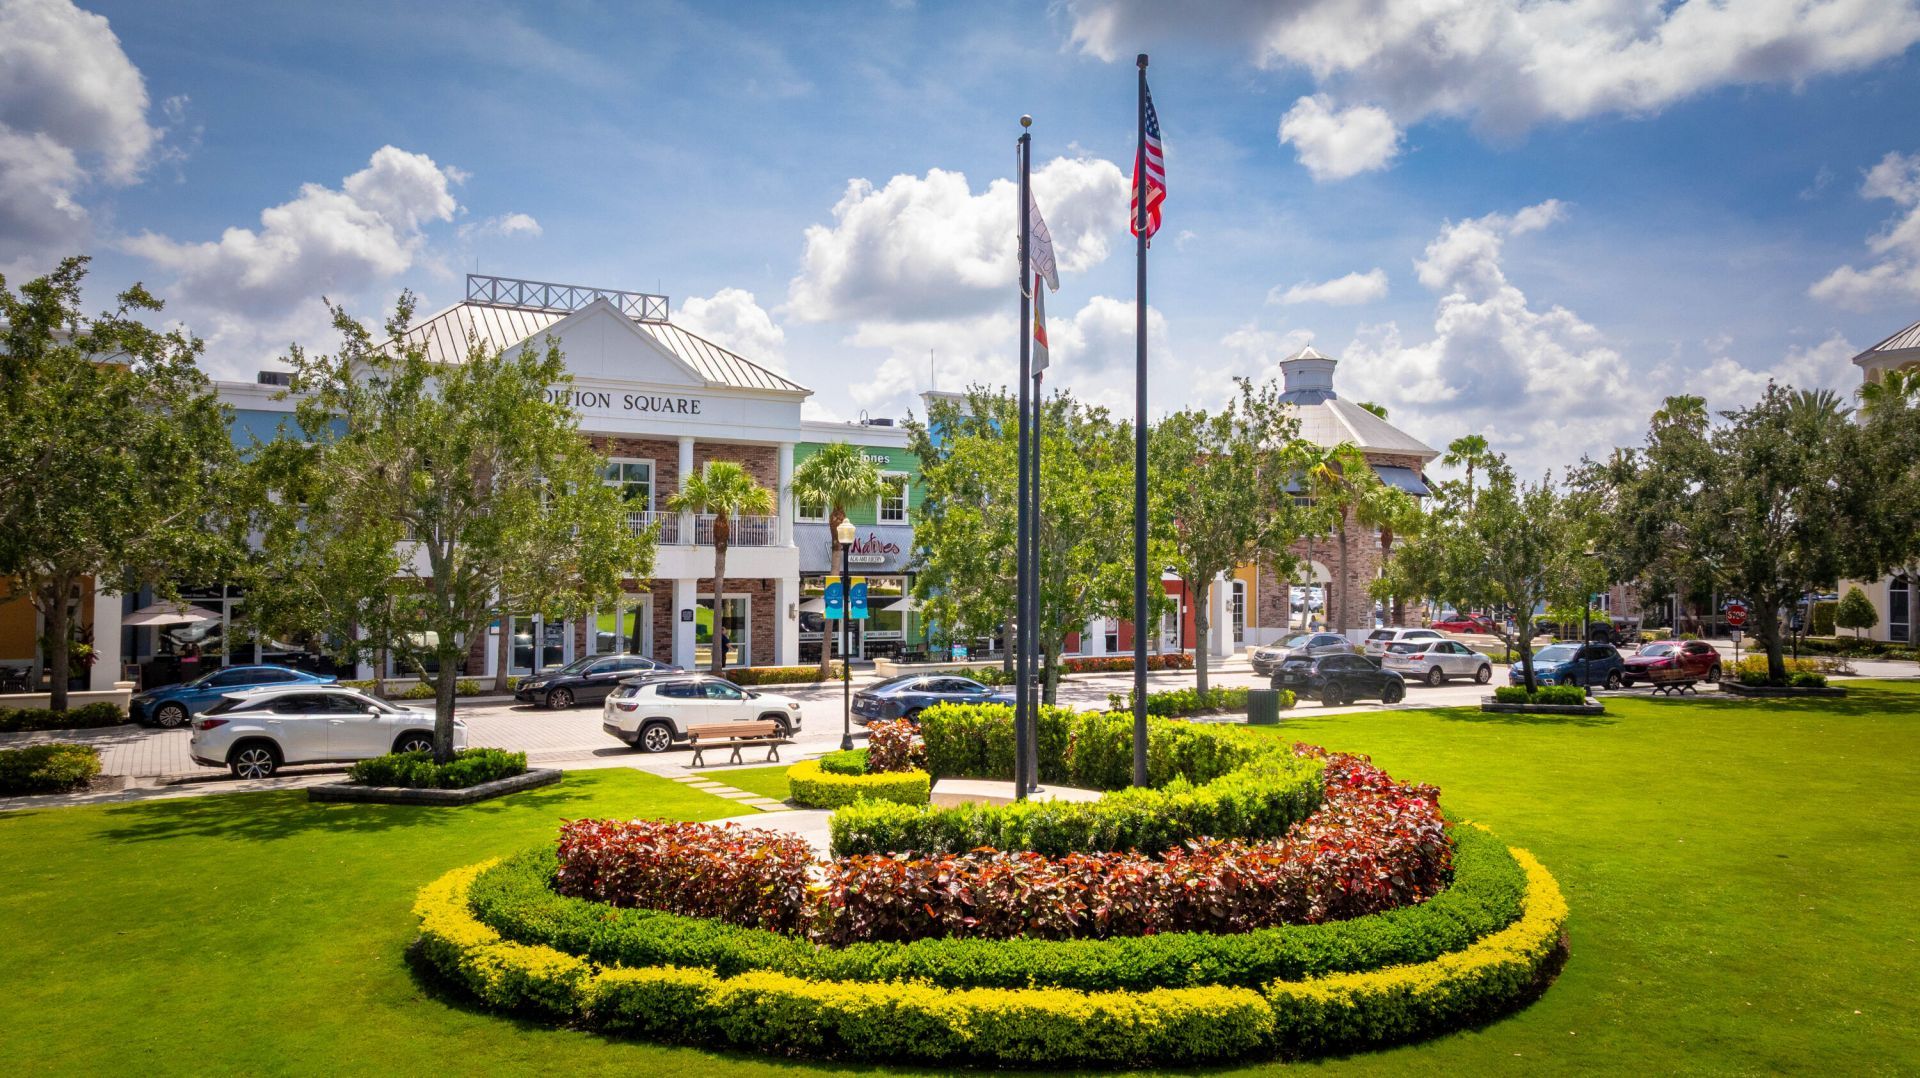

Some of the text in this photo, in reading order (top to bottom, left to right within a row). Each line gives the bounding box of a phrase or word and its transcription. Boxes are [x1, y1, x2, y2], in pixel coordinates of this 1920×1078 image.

[541, 388, 701, 415] DITION SQUARE
[1727, 611, 1745, 620] STOP
